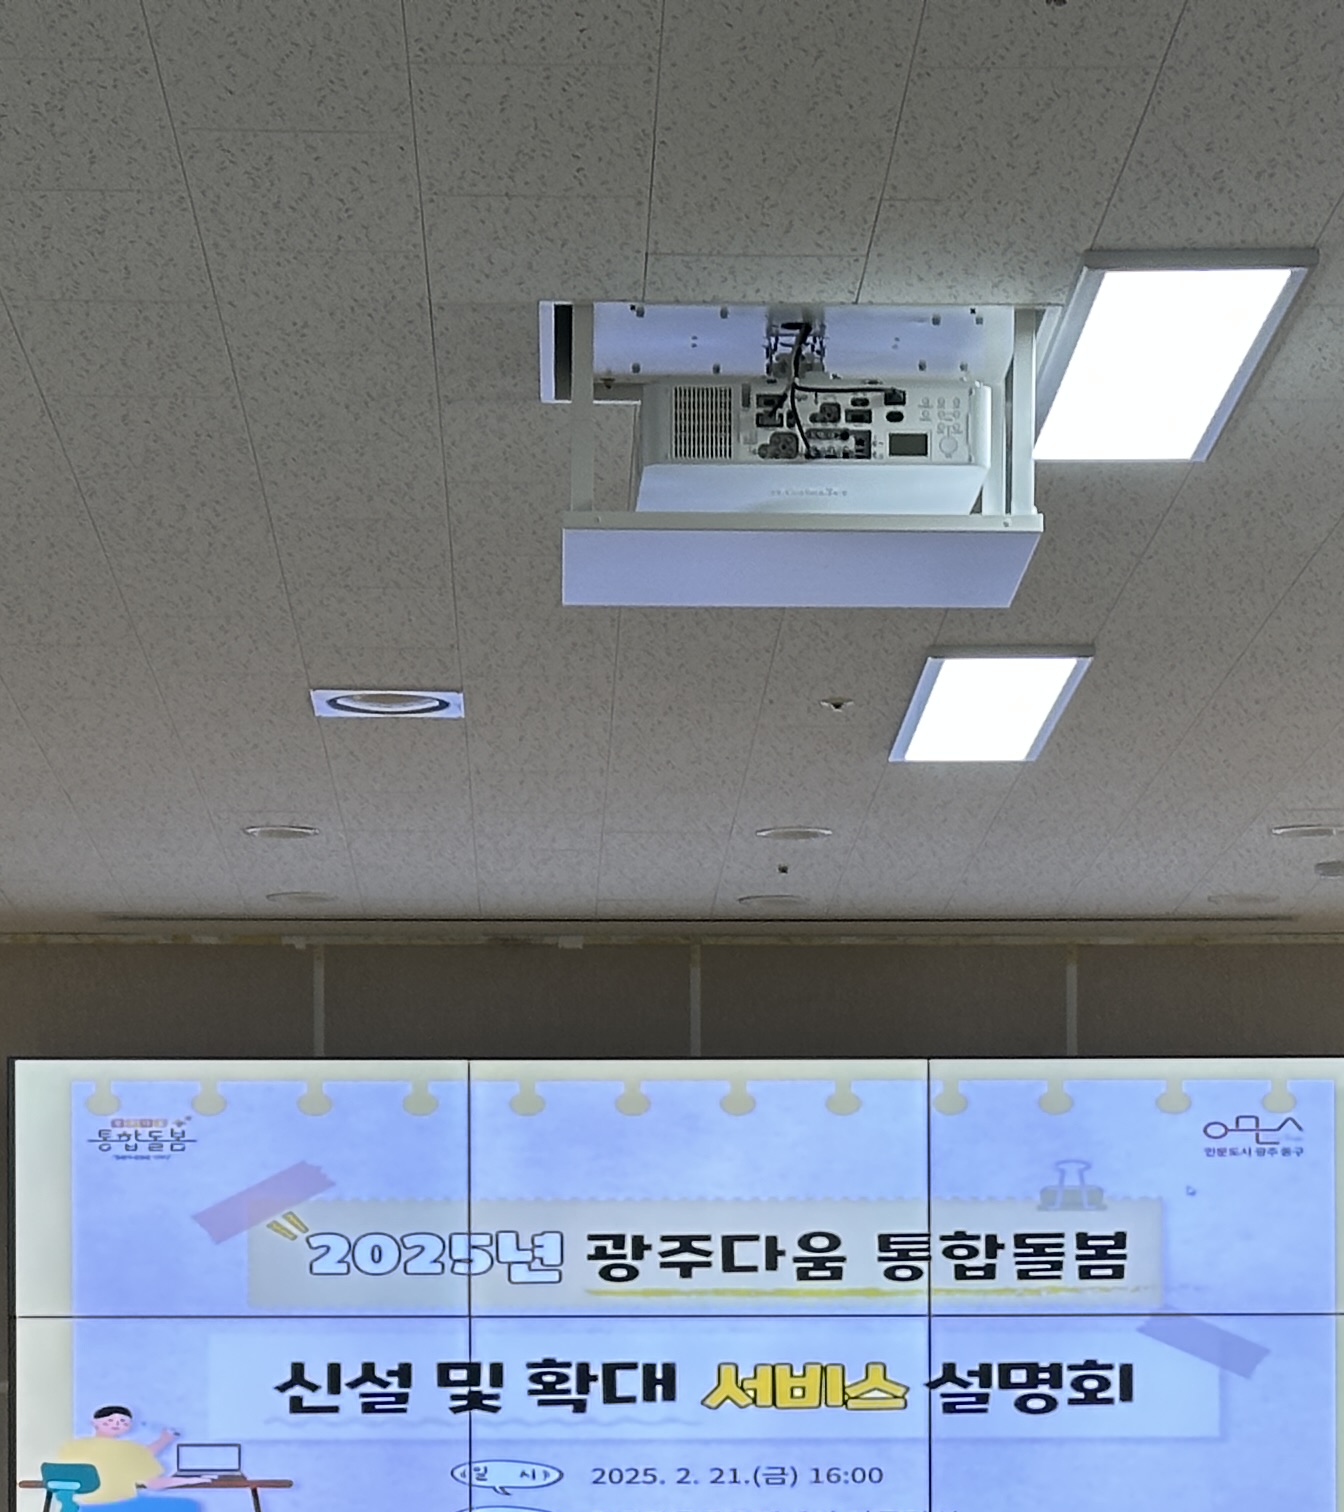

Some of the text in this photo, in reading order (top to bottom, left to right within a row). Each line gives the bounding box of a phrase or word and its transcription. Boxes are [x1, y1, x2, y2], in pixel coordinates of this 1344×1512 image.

[87, 1128, 197, 1152] 통합돌봄
[306, 1231, 1128, 1284] 2025년 광주다움 통합돌봄
[274, 1358, 1134, 1415] 신설 및 확대 서비스 설명회
[591, 1466, 883, 1487] 2025. 2. 21.(금) 16:00
